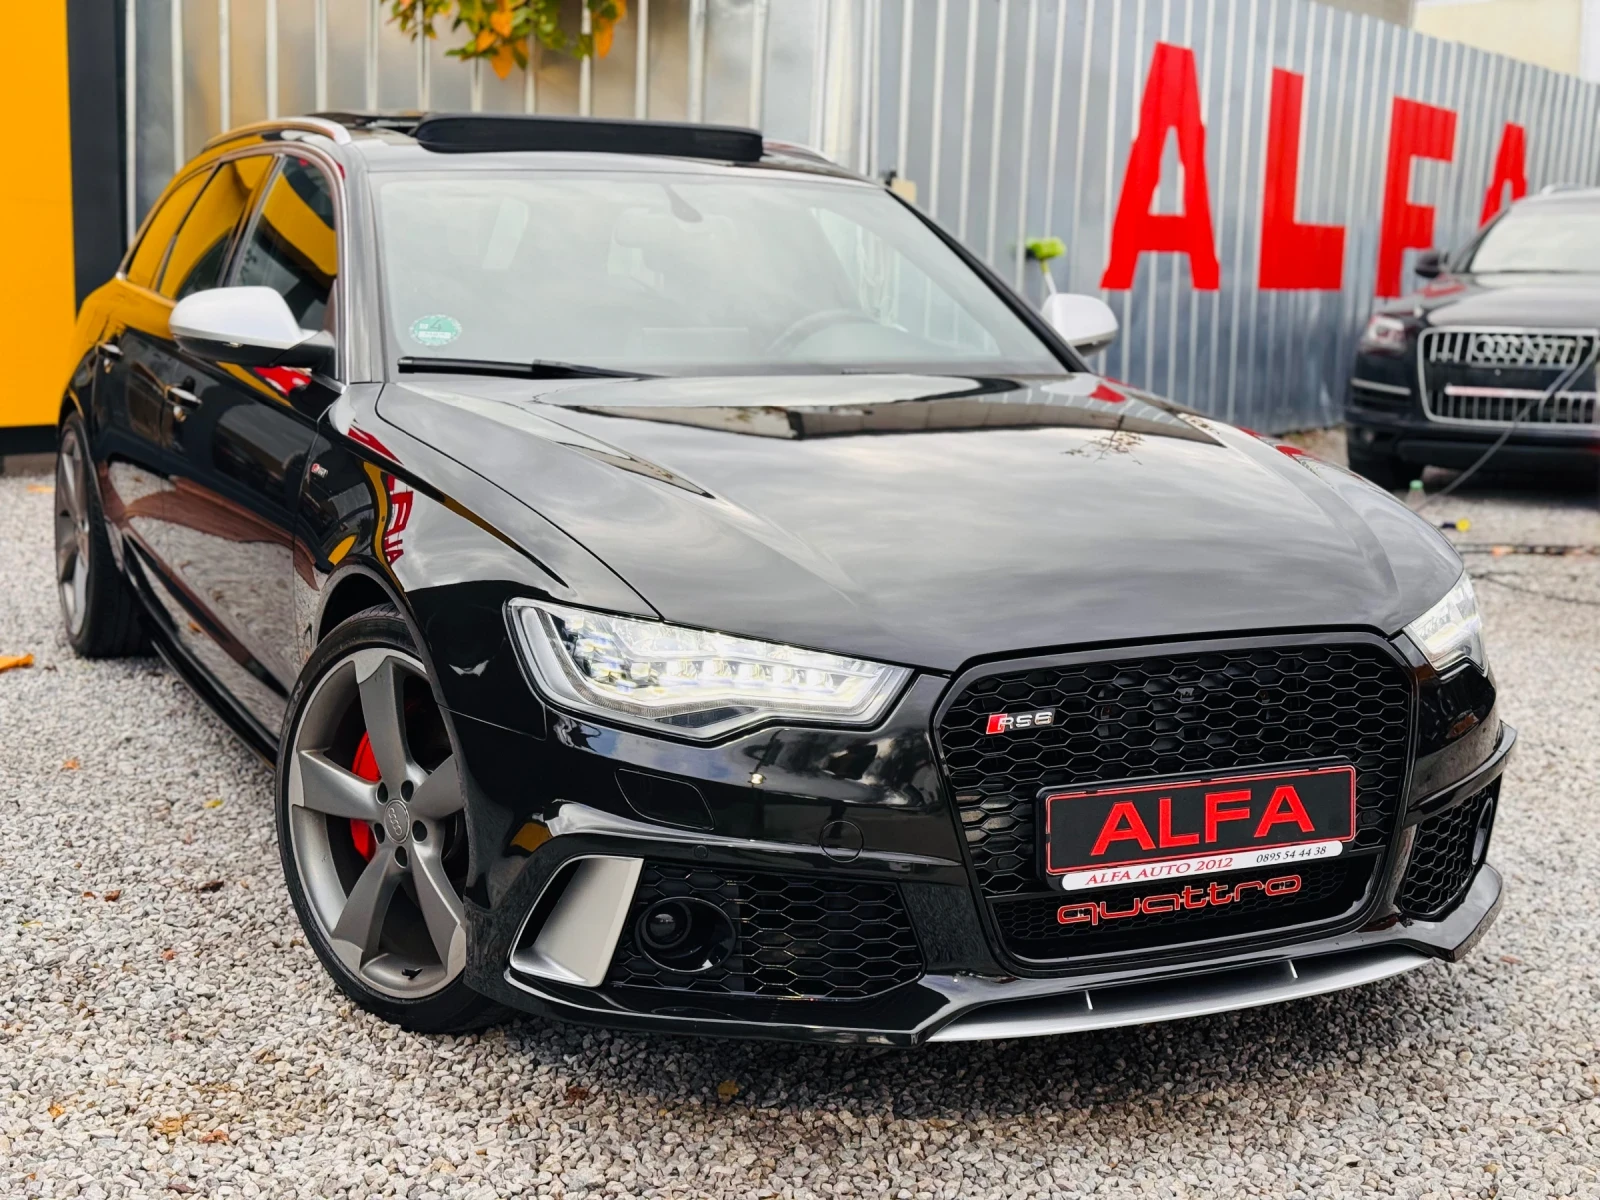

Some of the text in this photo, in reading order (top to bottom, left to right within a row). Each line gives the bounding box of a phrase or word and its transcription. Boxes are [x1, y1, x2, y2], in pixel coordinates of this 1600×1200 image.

[997, 711, 1053, 730] RS6
[1090, 785, 1315, 856] ALFA
[1256, 845, 1327, 864] 0895 54 44 38
[1085, 857, 1234, 885] ALFA AUTO 2012
[1057, 874, 1302, 926] quattro
